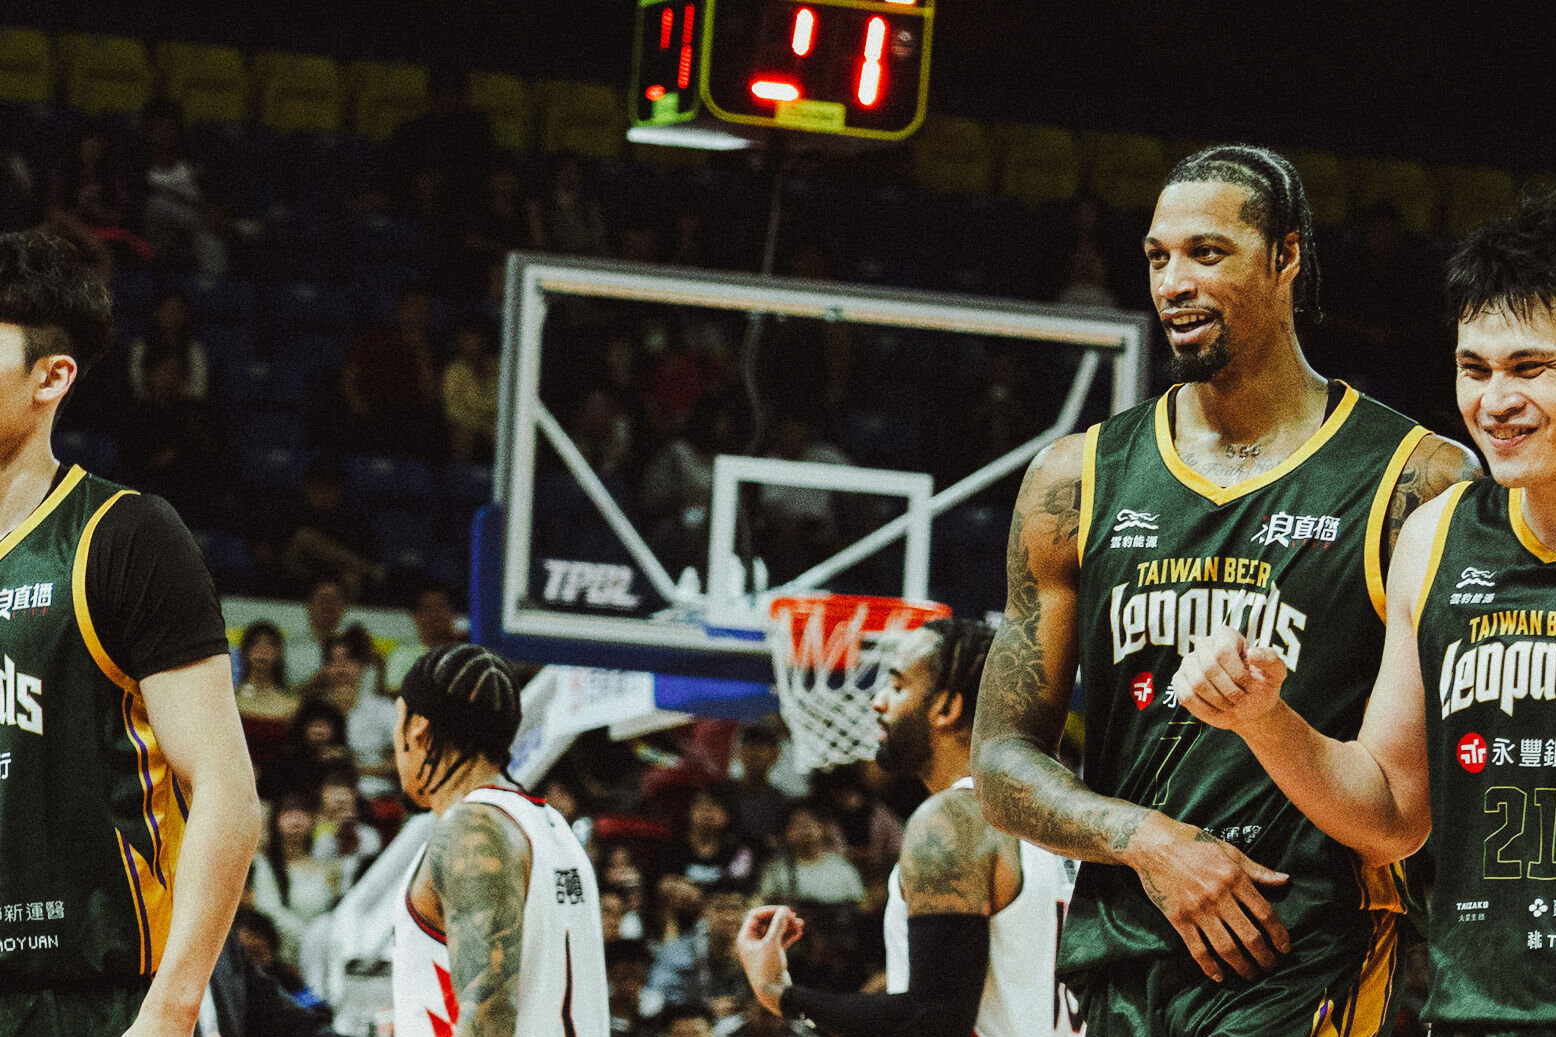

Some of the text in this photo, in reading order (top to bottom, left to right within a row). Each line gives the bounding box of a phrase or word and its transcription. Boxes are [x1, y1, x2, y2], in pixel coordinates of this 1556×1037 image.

[1250, 512, 1341, 548] 浪直播
[1137, 556, 1272, 589] TAIWAN BEER
[1469, 610, 1543, 643] TAIWAN
[0, 900, 64, 922] 新運醫
